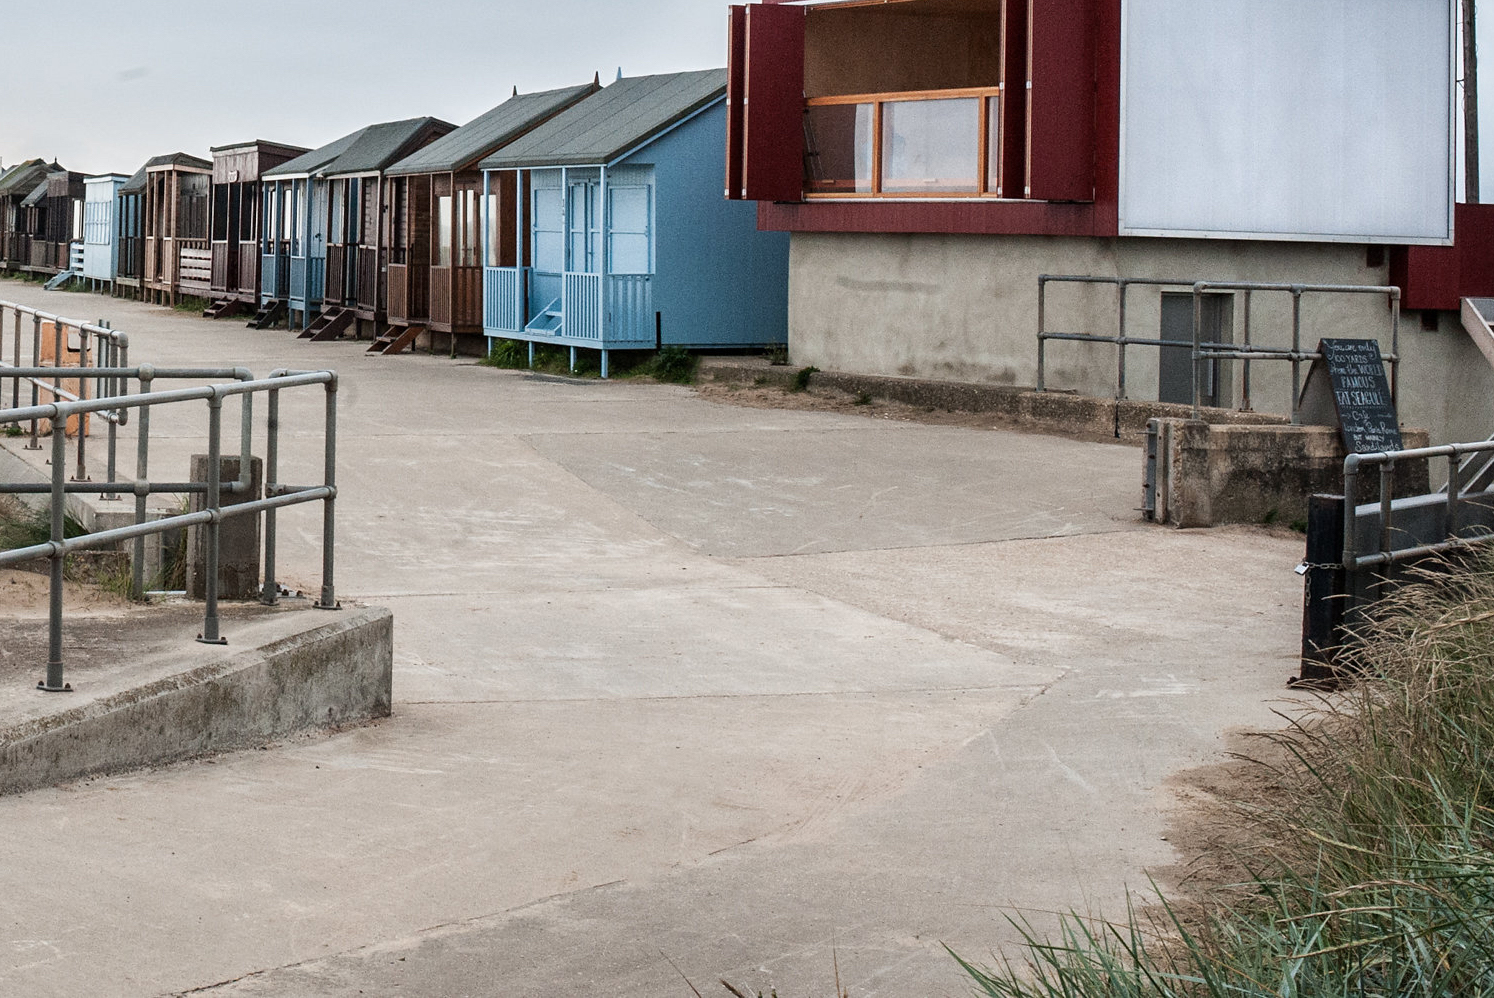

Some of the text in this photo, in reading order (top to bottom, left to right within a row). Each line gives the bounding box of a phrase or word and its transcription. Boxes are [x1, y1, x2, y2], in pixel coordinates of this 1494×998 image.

[1346, 354, 1368, 363] YARDS
[1340, 376, 1375, 388] FAMOUS
[1351, 391, 1387, 406] SEAGULL
